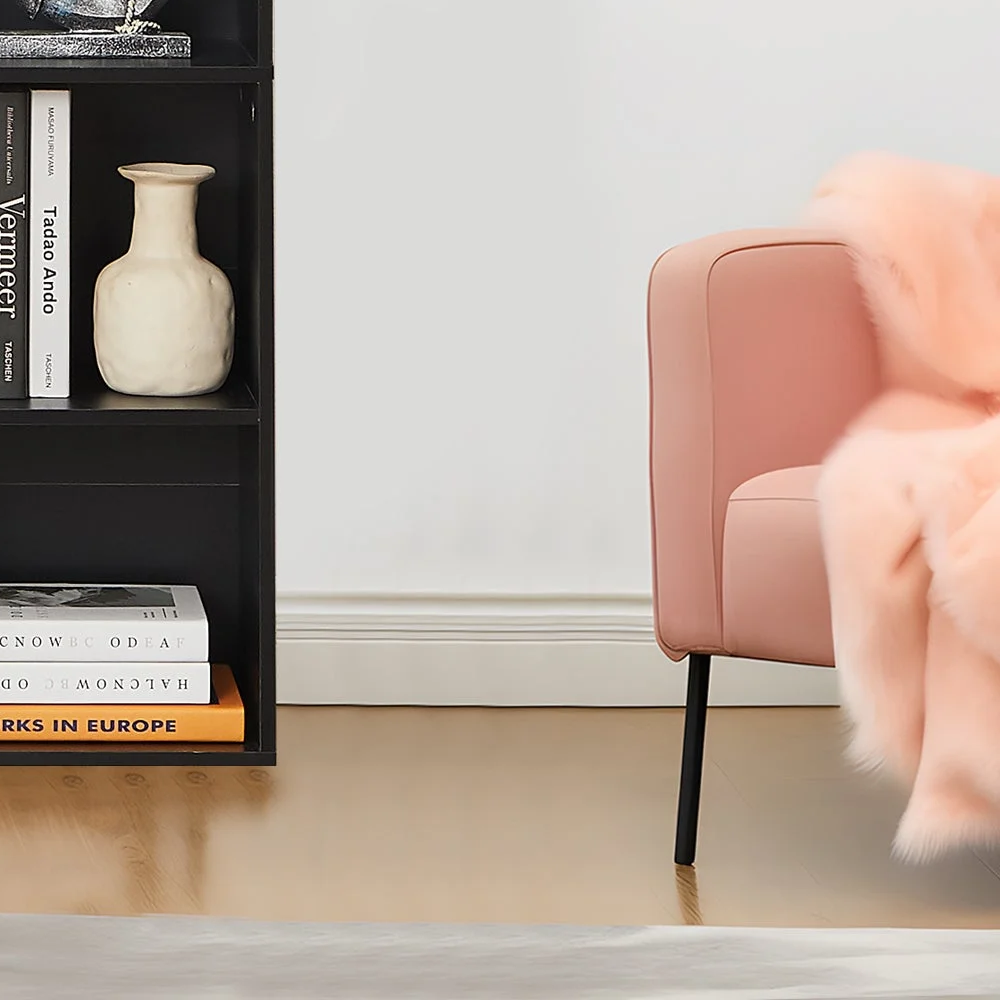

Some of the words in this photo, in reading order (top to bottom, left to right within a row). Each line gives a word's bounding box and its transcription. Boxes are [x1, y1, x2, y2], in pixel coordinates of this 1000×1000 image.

[47, 106, 55, 134] MASAO
[47, 135, 55, 177] FURUYAMA
[43, 206, 58, 261] Tadao
[43, 267, 58, 315] Ando
[3, 341, 13, 382] TASCHEN
[44, 353, 52, 389] TASCHEN
[53, 718, 78, 733] IN
[87, 718, 177, 733] EUROPE
